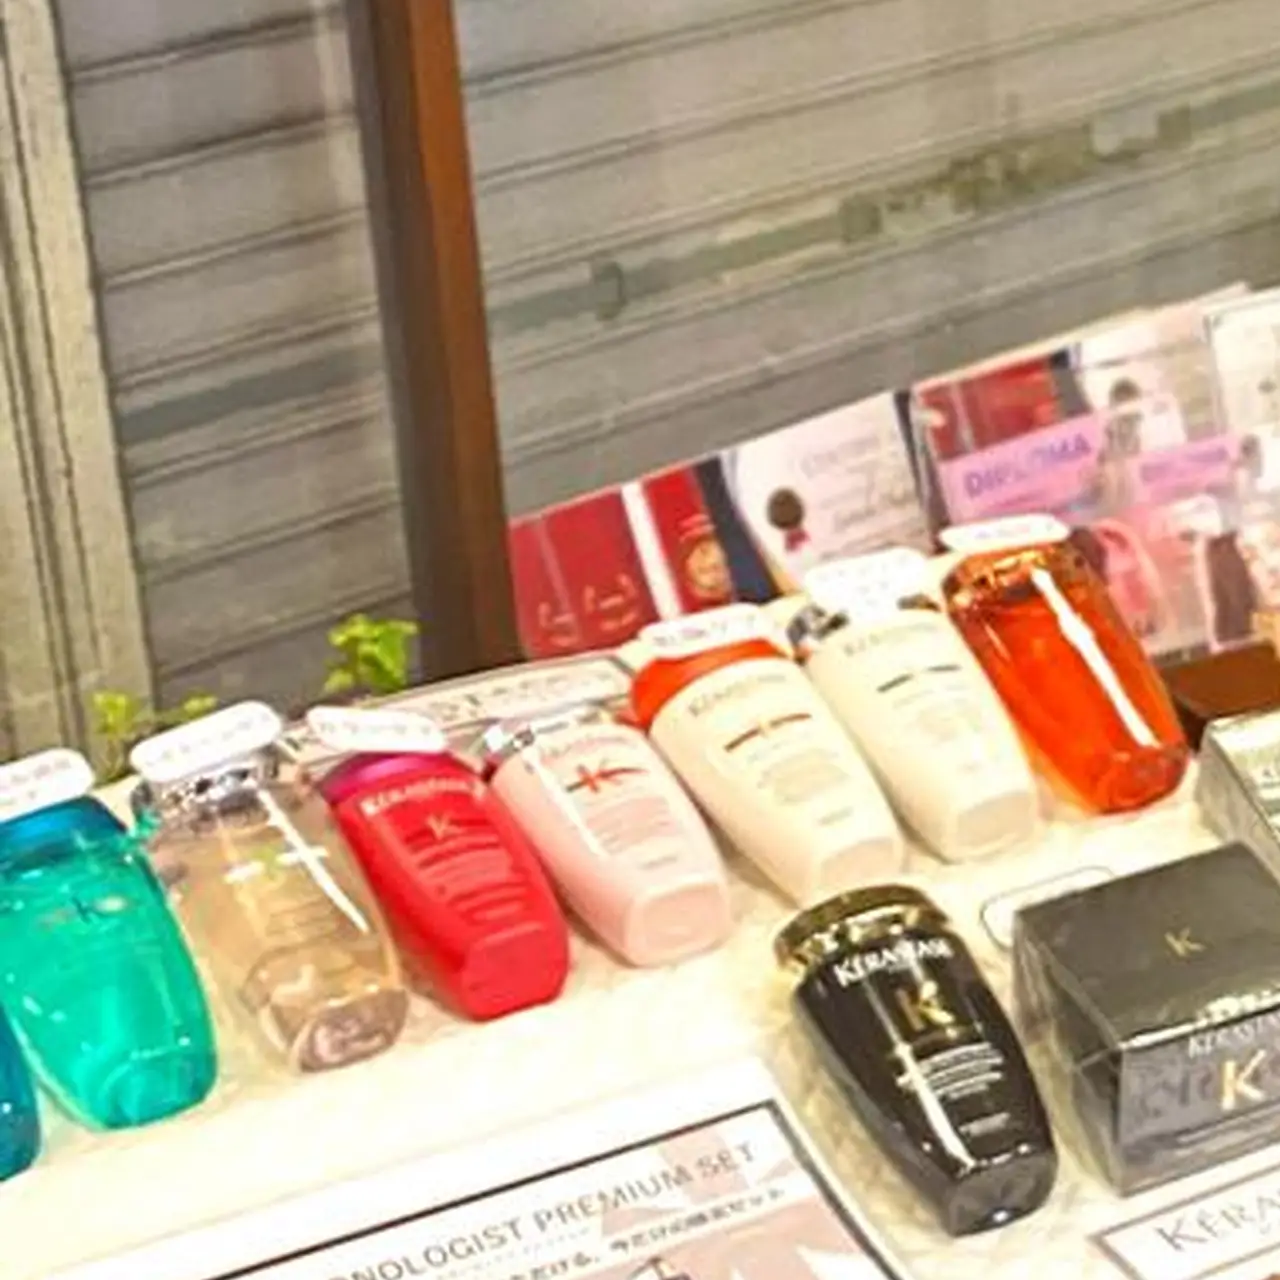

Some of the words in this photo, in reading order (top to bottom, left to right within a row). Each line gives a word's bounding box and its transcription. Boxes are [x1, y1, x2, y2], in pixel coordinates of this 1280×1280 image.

[1164, 927, 1207, 956] K
[1222, 1049, 1267, 1110] K
[533, 1164, 693, 1231] PREMIUM
[696, 1141, 758, 1178] SET
